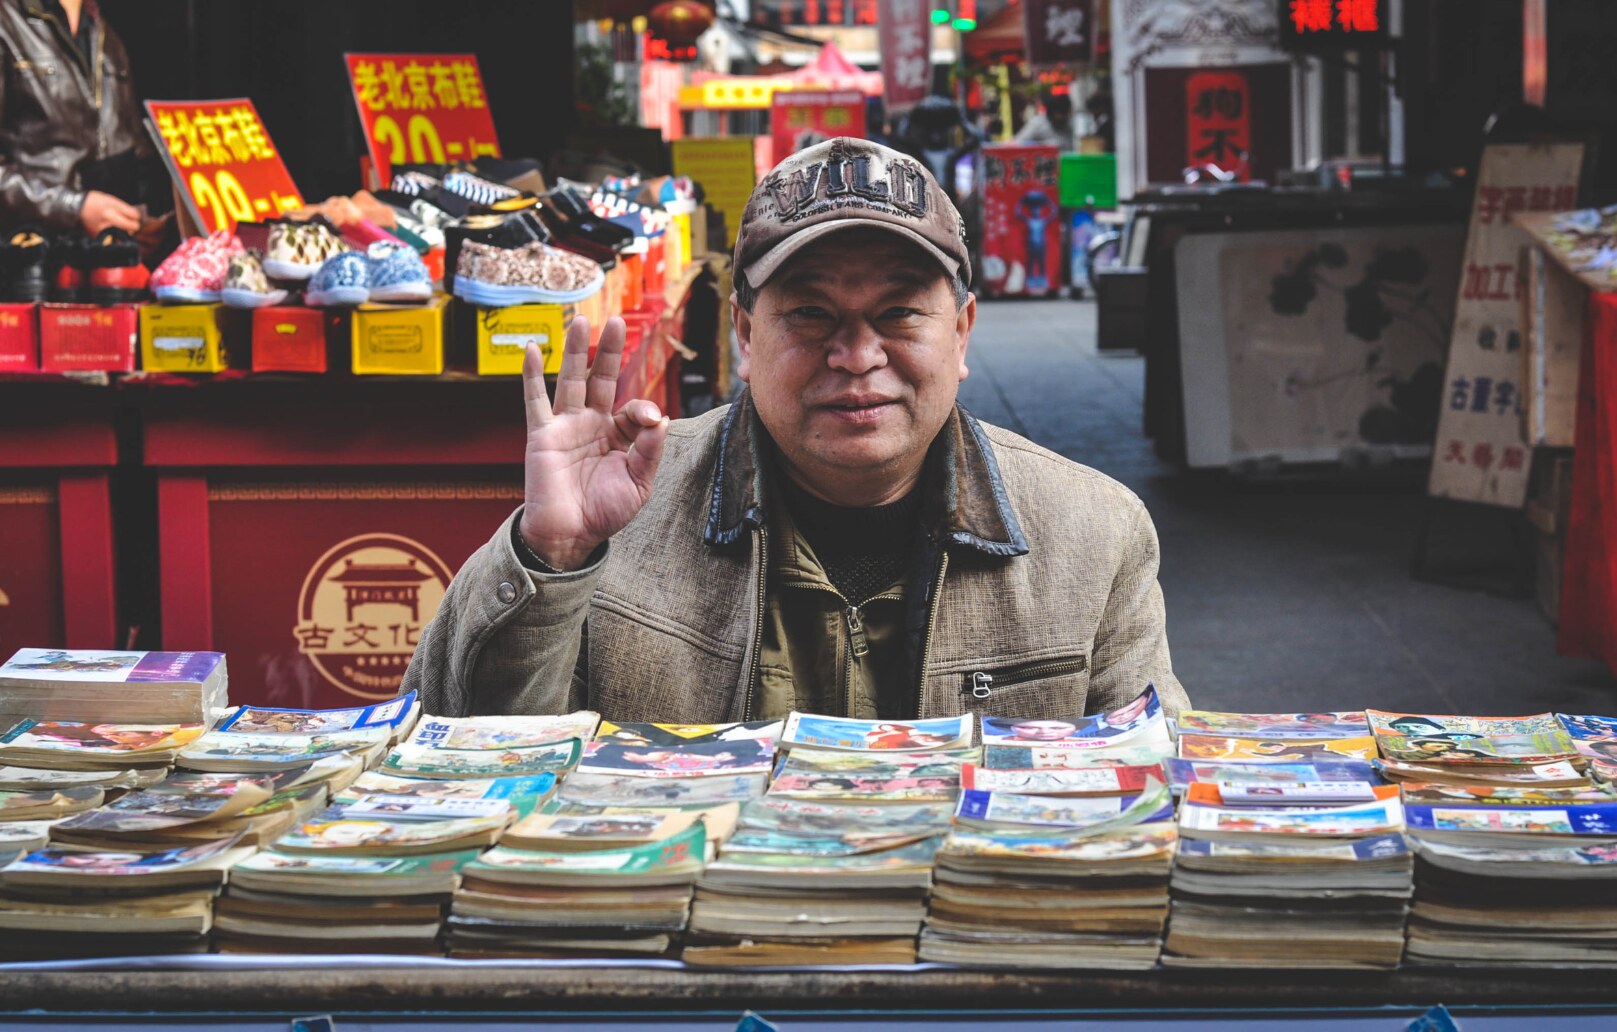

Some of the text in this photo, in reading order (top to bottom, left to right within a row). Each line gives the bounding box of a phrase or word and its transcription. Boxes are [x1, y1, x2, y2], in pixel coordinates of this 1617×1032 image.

[355, 60, 485, 111] 老北京布鞋
[158, 105, 274, 167] 老北京布鞋
[767, 156, 926, 220] WILD
[1463, 262, 1521, 300] 加工
[1451, 373, 1522, 416] 古董字
[298, 623, 420, 650] 古文化
